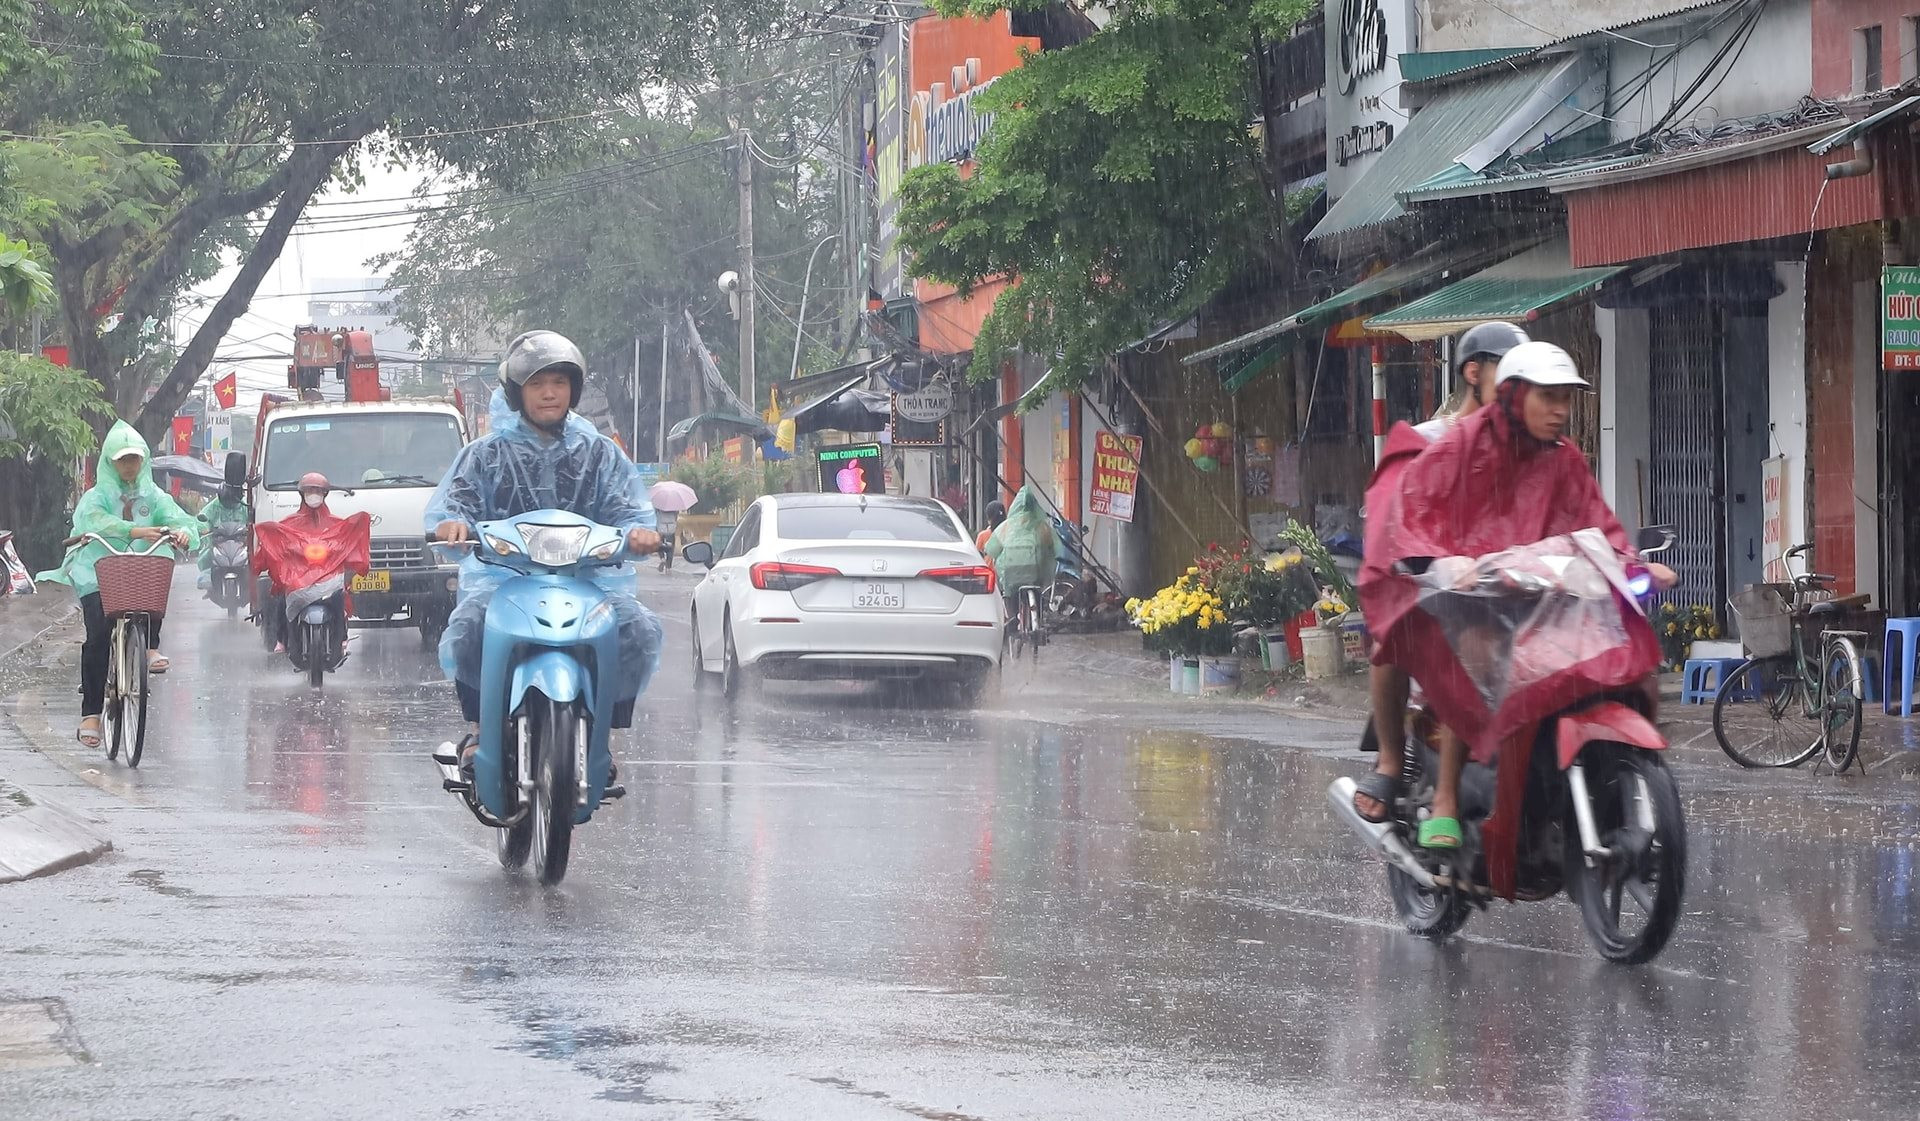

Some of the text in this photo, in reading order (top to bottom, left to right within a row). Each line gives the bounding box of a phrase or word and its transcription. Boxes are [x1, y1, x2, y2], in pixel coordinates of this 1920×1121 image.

[1887, 290, 1913, 320] HÚT
[1887, 329, 1909, 345] RAU
[840, 448, 878, 459] COMPUTER
[1099, 474, 1132, 494] NHÀ
[868, 584, 889, 595] 30L
[858, 596, 898, 607] 924.05
